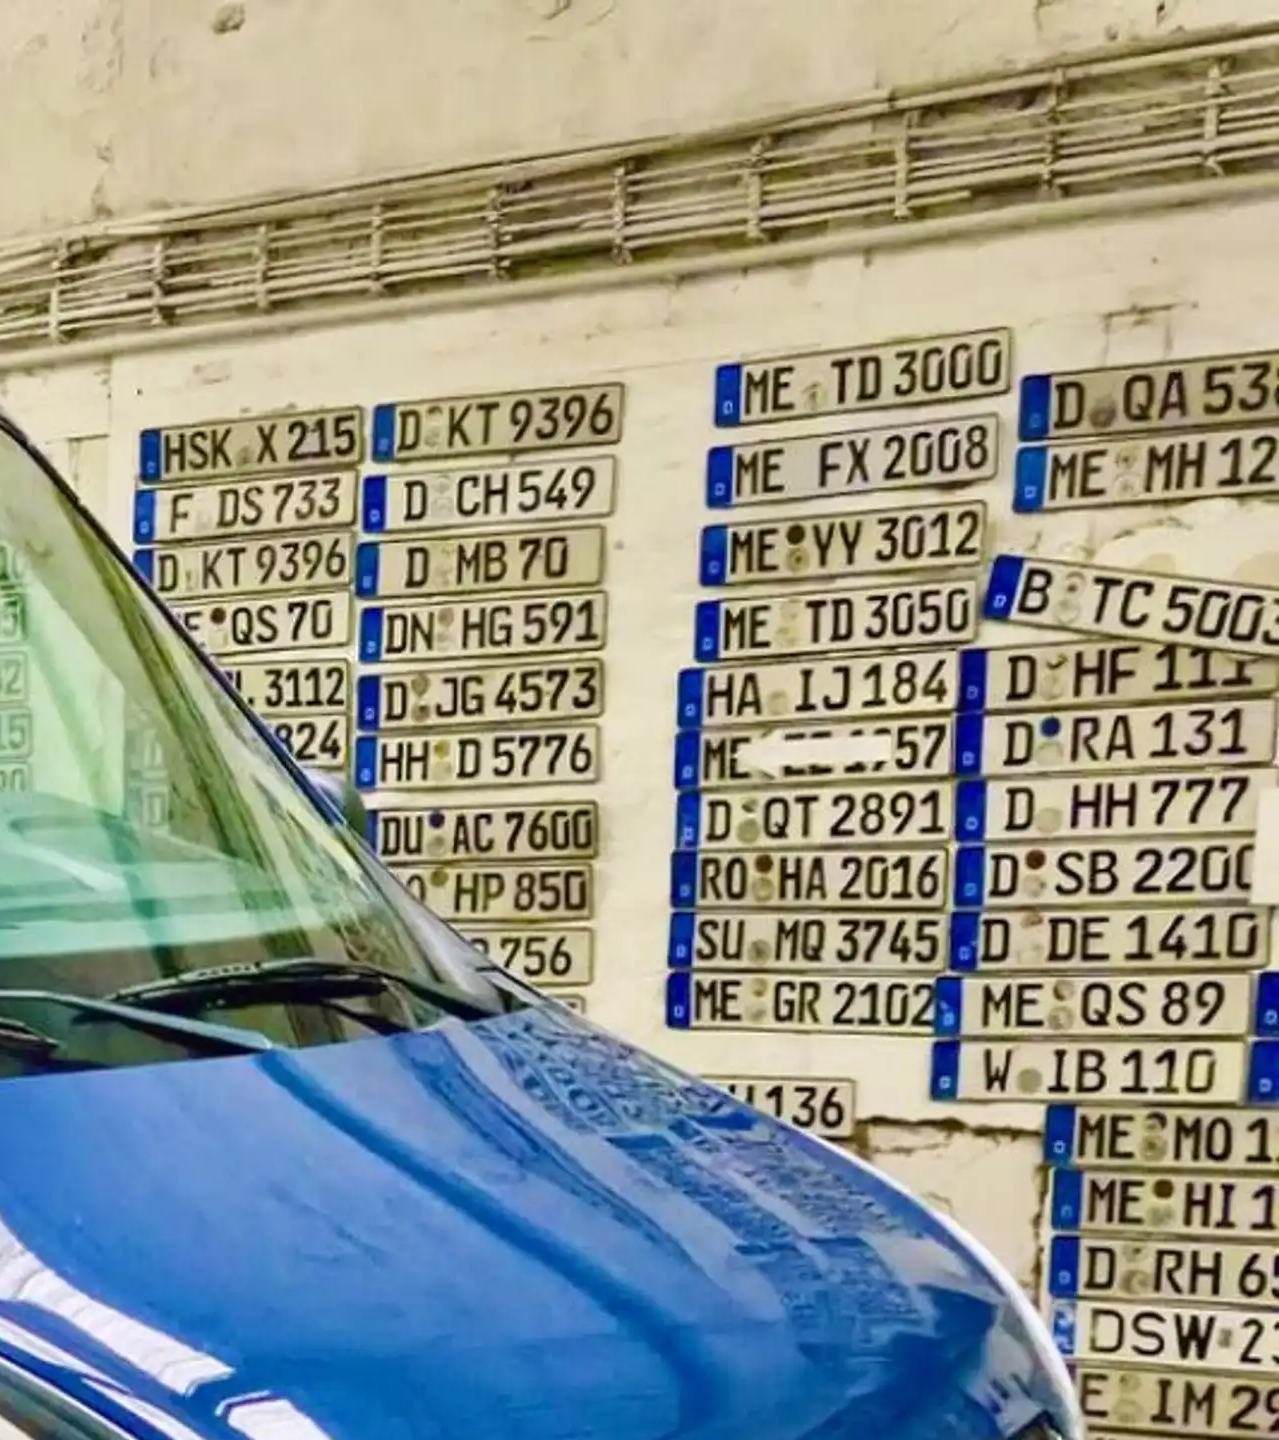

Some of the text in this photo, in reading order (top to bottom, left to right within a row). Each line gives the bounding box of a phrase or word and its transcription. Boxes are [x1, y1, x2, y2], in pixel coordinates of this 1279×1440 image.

[745, 339, 1002, 416] ME TD 3000
[1054, 362, 1279, 430] D QA 53
[163, 414, 357, 473] HSK X 215
[397, 393, 614, 451] D KT 9396
[736, 425, 989, 497] ME FX 2008
[1049, 436, 1278, 500] ME MH 12
[169, 477, 341, 533] F DS 733
[404, 467, 595, 521] D CH 549
[158, 537, 347, 592] D KT 9396
[405, 537, 569, 587] D MB 70
[730, 511, 978, 575] ME YY 3012
[231, 605, 278, 646] QS
[288, 600, 332, 641] 70
[724, 588, 970, 651] ME TD 3050
[1018, 567, 1052, 614] B
[1094, 578, 1155, 628] TC
[386, 600, 598, 653] DN HG 591
[265, 667, 345, 708] 3112
[384, 667, 597, 721] D JG 4573
[707, 660, 947, 717] HA IJ 184
[1007, 655, 1036, 701] D
[1074, 646, 1140, 697] HF
[381, 733, 593, 782] HH D 5776
[703, 737, 751, 780] ME
[1004, 708, 1248, 766] D RA 131
[707, 790, 943, 842] D QT 2891
[1005, 776, 1250, 831] D HH 777
[382, 810, 592, 855] DU AC 7600
[454, 874, 504, 912] HP
[514, 870, 587, 911] 850
[700, 855, 939, 901] RO HA 2016
[989, 853, 1019, 897] D
[1055, 850, 1119, 895] SB
[501, 936, 572, 976] 756
[696, 919, 940, 963] SU MQ 3745
[981, 913, 1258, 961] D DE 1410
[695, 980, 936, 1027] ME GR 2102
[981, 980, 1226, 1028] ME QS 89
[984, 1049, 1216, 1094] W IB 110
[766, 1085, 844, 1128] 136
[1078, 1114, 1279, 1163] ME MO 1
[1088, 1179, 1145, 1224] ME
[1183, 1182, 1236, 1228] HI
[1084, 1247, 1279, 1298] D RH 6
[1089, 1308, 1279, 1364] DSW 2
[1150, 1379, 1216, 1427] IM
